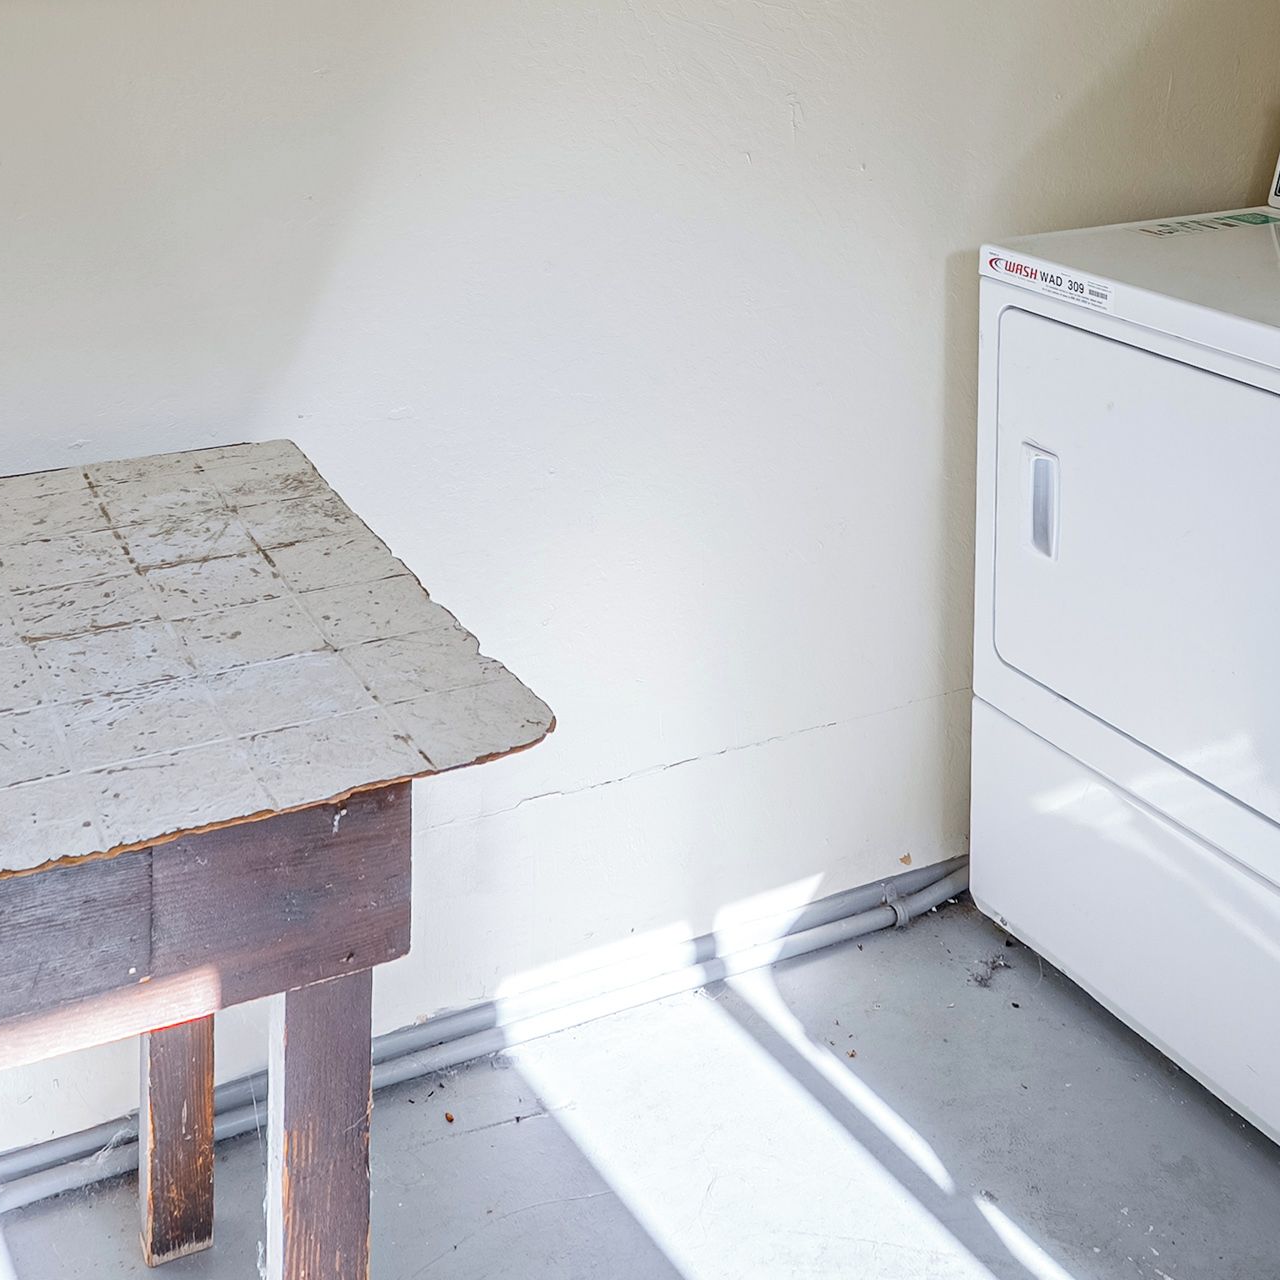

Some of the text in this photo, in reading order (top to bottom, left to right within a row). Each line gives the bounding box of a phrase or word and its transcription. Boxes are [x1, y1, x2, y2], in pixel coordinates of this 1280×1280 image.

[1004, 260, 1038, 281] WASH
[1039, 270, 1063, 287] WAD
[1067, 279, 1085, 295] 309
